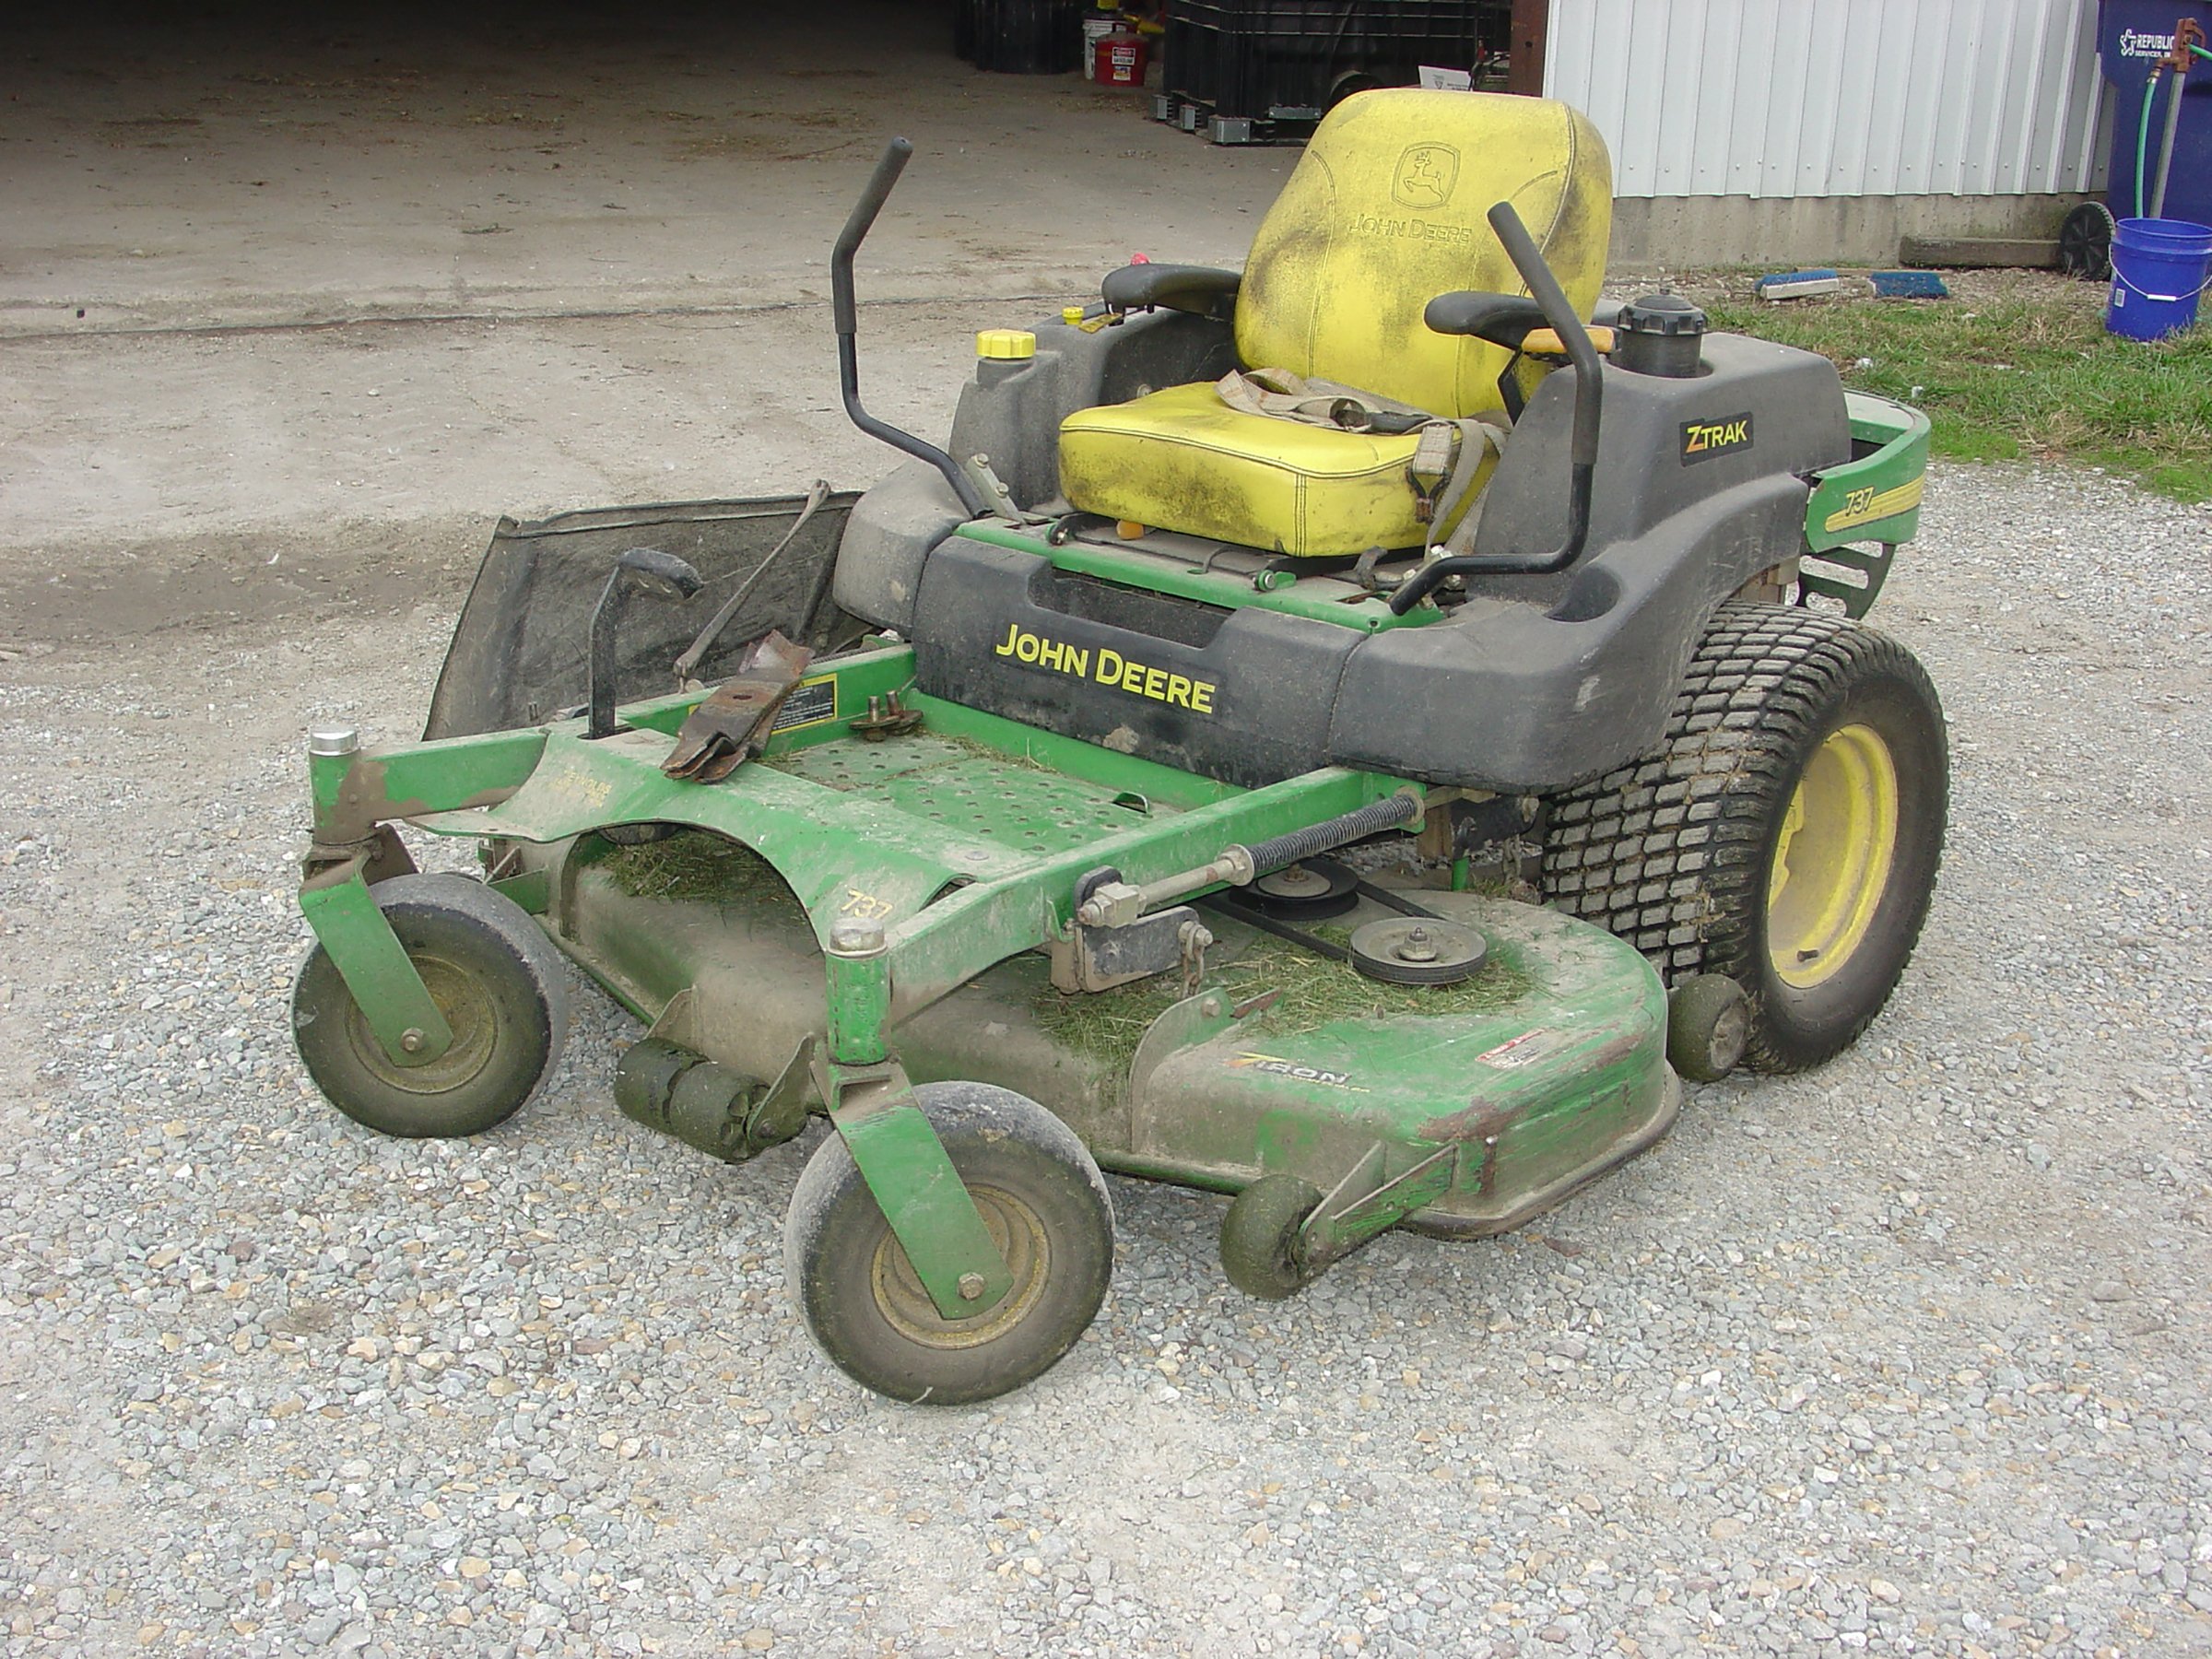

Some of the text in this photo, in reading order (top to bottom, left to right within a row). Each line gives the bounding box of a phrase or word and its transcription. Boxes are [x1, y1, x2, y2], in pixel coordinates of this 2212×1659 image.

[1349, 213, 1472, 244] JOHN DEERE
[1844, 486, 1876, 518] 737
[995, 624, 1217, 714] JOHN DEERE
[841, 888, 894, 920] 737
